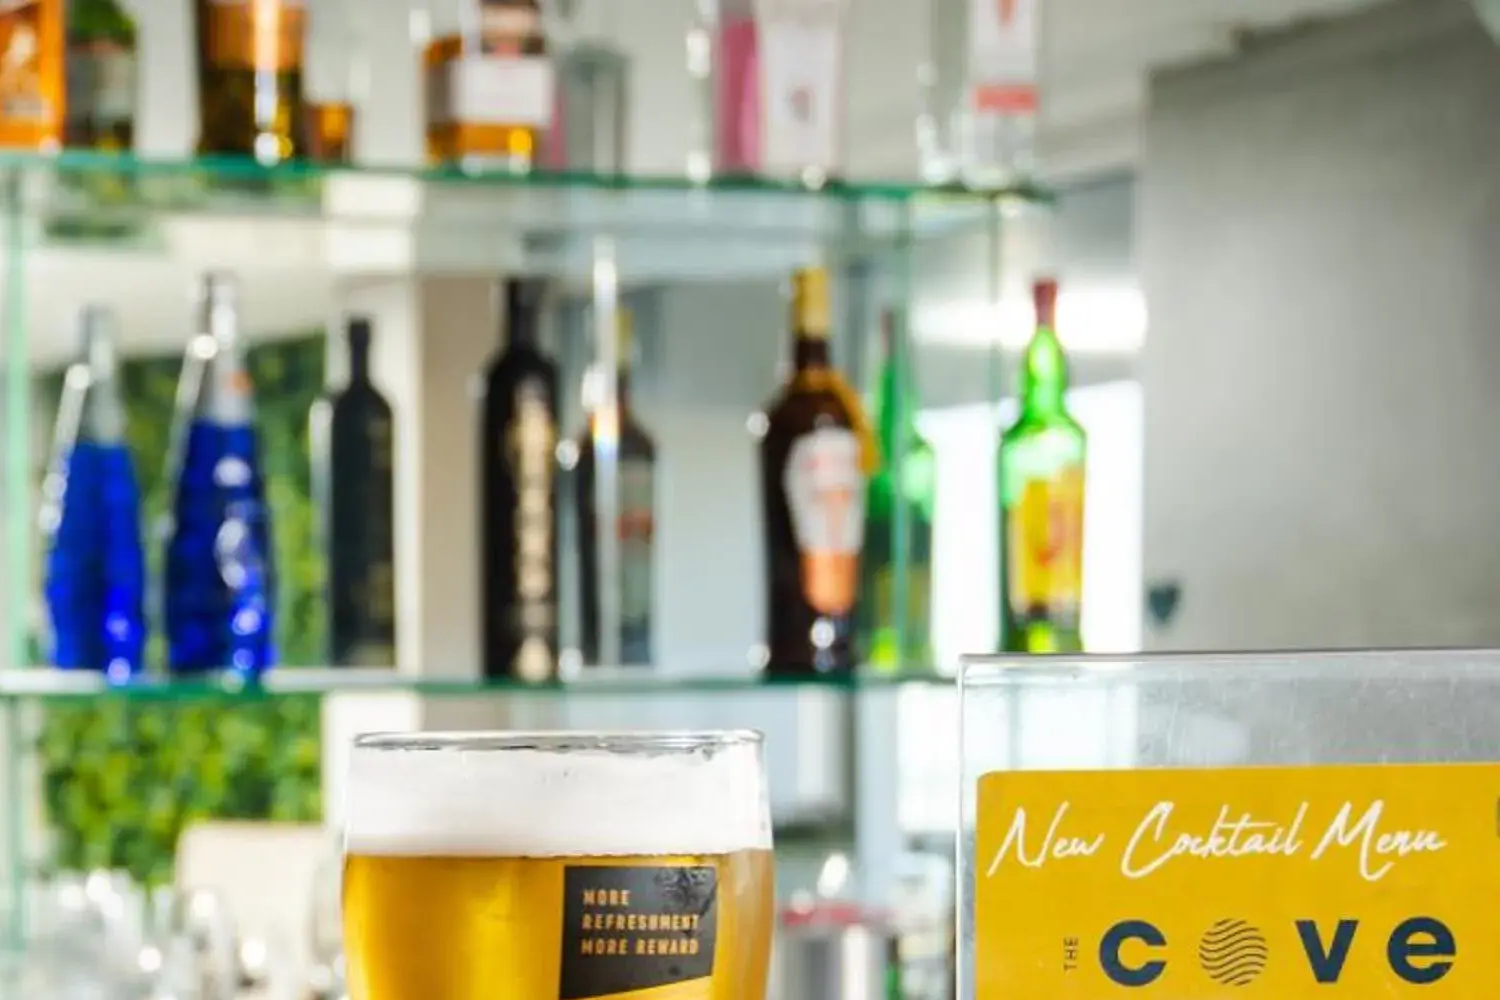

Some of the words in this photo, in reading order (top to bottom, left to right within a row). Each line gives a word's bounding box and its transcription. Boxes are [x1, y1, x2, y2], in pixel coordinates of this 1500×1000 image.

[987, 801, 1104, 877] New
[1121, 801, 1309, 879] Cocktail
[1311, 799, 1448, 881] Menu
[582, 889, 631, 906] MORE
[582, 914, 699, 930] REFRESHMENT
[581, 938, 628, 955] MORE
[635, 938, 699, 955] REWARD
[1063, 936, 1079, 971] THE
